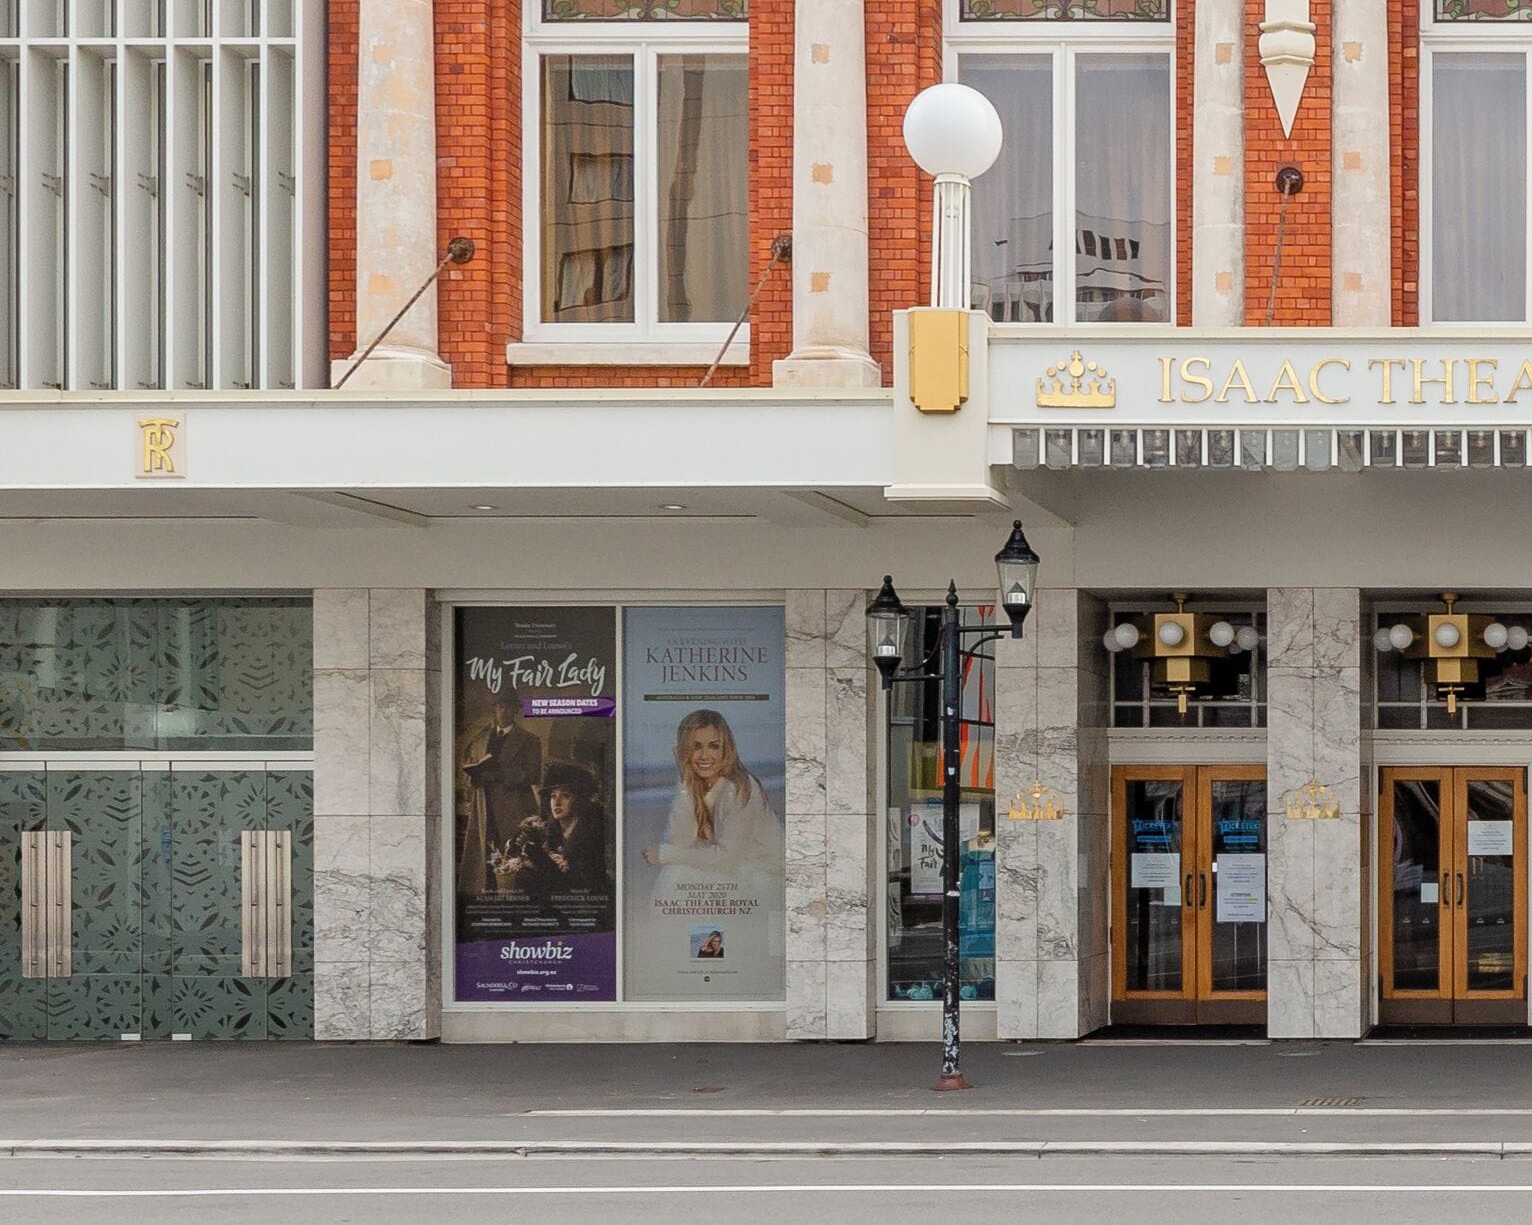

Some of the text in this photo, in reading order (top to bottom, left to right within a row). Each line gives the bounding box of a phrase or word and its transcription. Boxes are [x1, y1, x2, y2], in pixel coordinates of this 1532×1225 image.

[1157, 356, 1352, 405] ISAAC
[646, 646, 769, 664] KATHERINE
[465, 652, 606, 697] My Fair Lady
[662, 664, 748, 683] JENKINS
[531, 699, 549, 707] NEW
[549, 699, 576, 707] SEASON
[676, 883, 715, 891] MONDAY
[687, 891, 706, 899] MAY
[654, 899, 759, 907] ISAAC THEATRE ROYAL
[662, 907, 752, 915] CHRISTCHURCH NZ
[500, 940, 574, 960] showbiz
